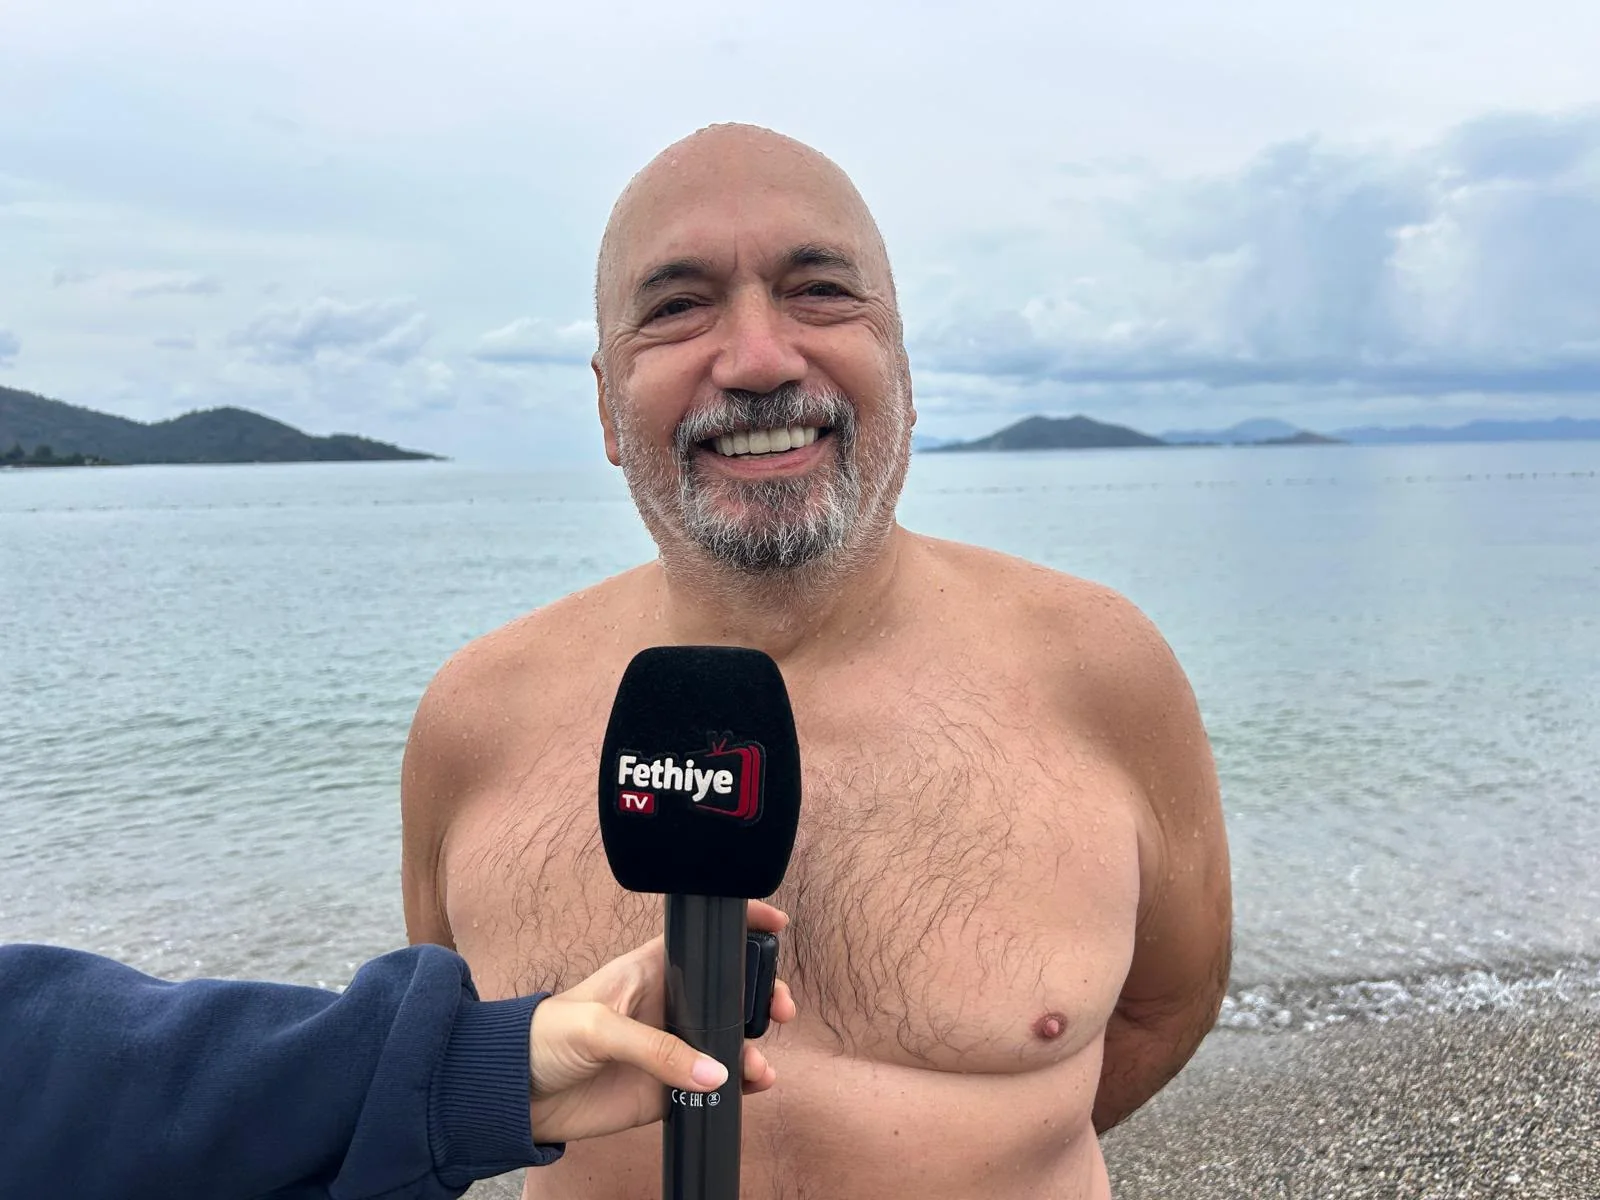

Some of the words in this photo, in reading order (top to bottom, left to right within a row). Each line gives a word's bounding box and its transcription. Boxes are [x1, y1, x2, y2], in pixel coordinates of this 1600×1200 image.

[618, 755, 734, 802] Fethiye
[622, 793, 649, 810] TV
[671, 1089, 687, 1106] CE
